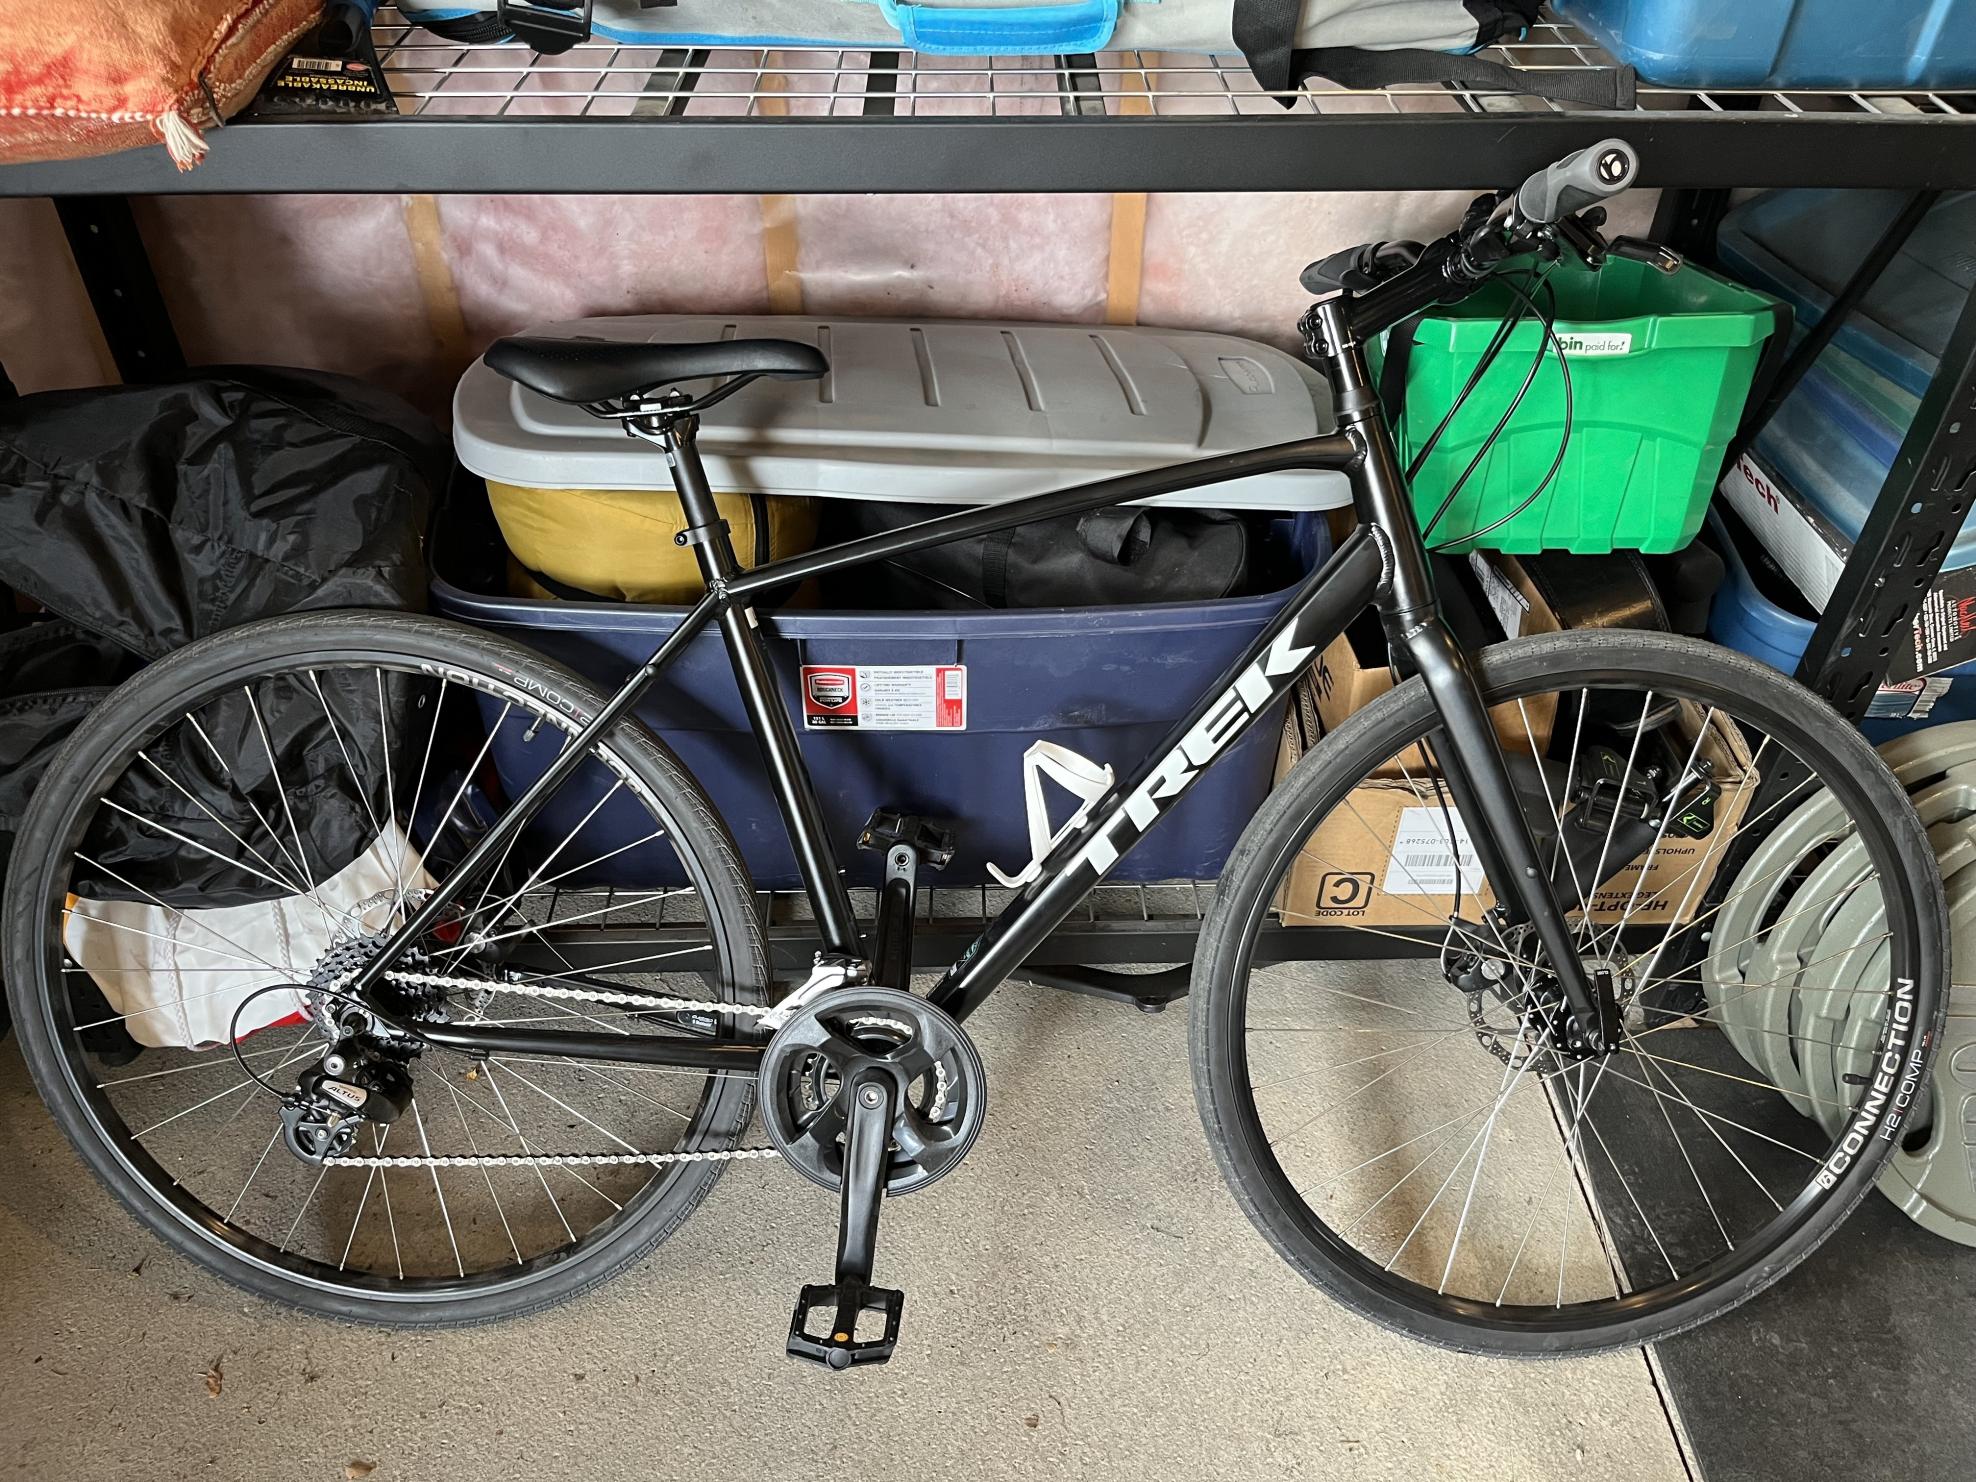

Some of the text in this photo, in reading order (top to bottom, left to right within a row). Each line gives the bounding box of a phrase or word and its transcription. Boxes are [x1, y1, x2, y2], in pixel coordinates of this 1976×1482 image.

[277, 80, 375, 93] UNBREAKABLE
[1558, 337, 1583, 350] bin
[1585, 341, 1606, 354] paid
[1065, 616, 1317, 877] TREK
[1330, 877, 1360, 905] C
[1828, 977, 1915, 1175] CONNECTION
[328, 1086, 361, 1102] ALTUS
